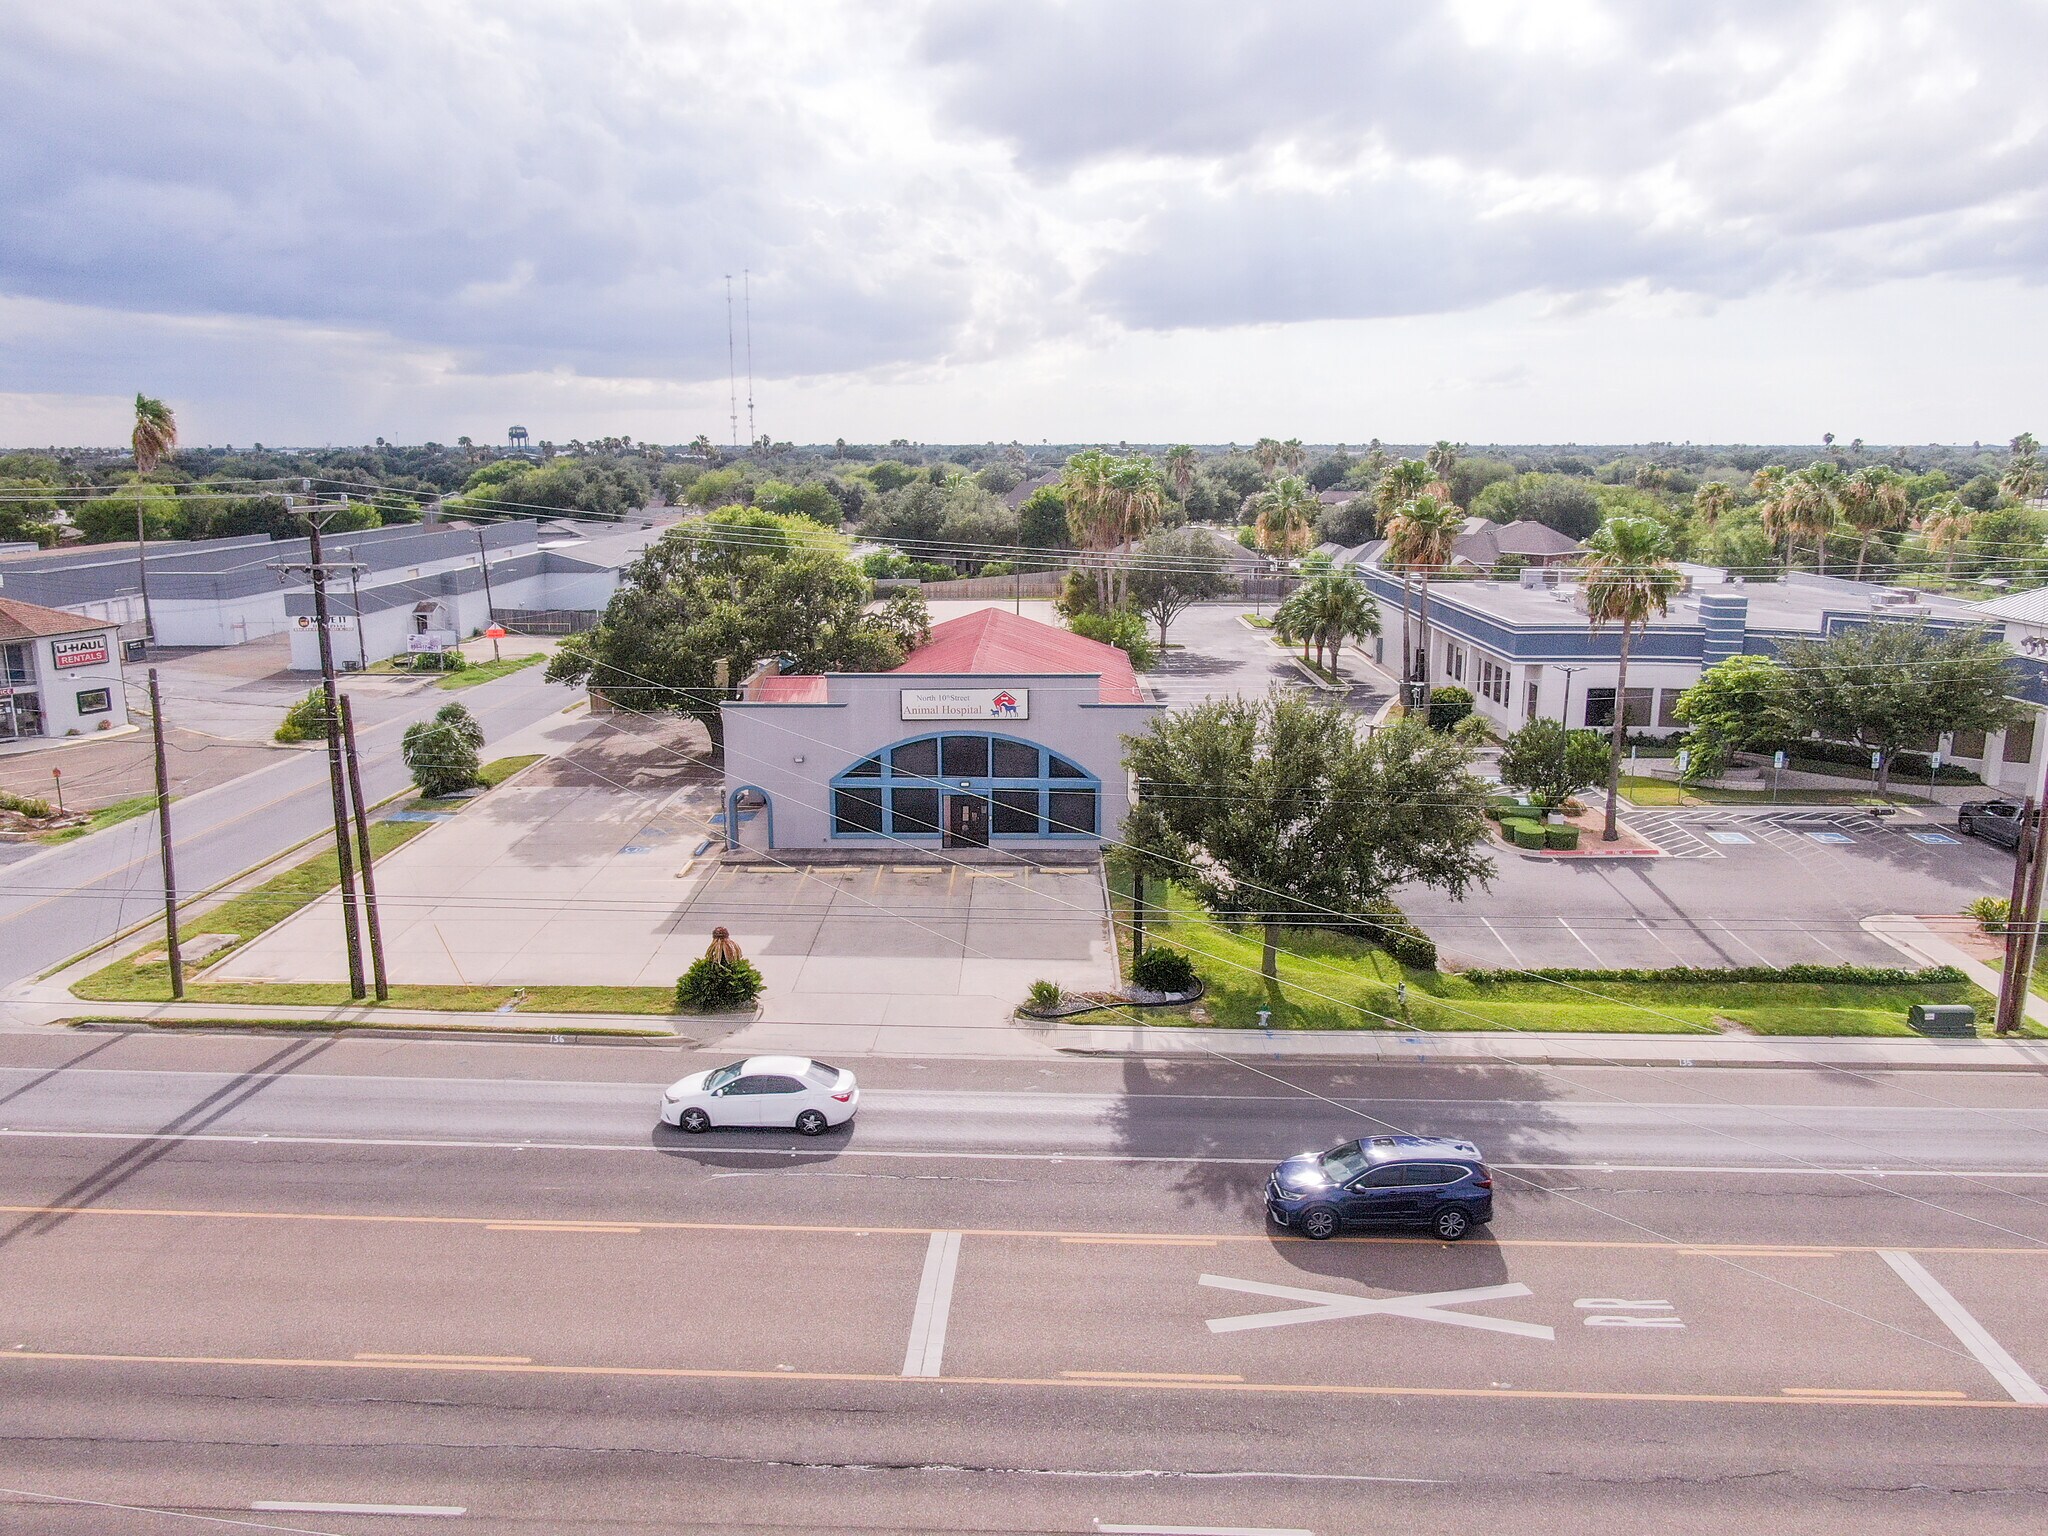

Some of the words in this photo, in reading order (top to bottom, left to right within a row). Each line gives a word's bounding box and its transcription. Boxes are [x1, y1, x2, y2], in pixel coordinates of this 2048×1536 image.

[56, 640, 104, 654] U-HAUL
[61, 652, 103, 664] RENTALS
[916, 694, 936, 702] North
[950, 694, 970, 702] Street
[903, 705, 939, 715] Animal
[942, 705, 982, 717] Hospital
[550, 1034, 565, 1043] 136
